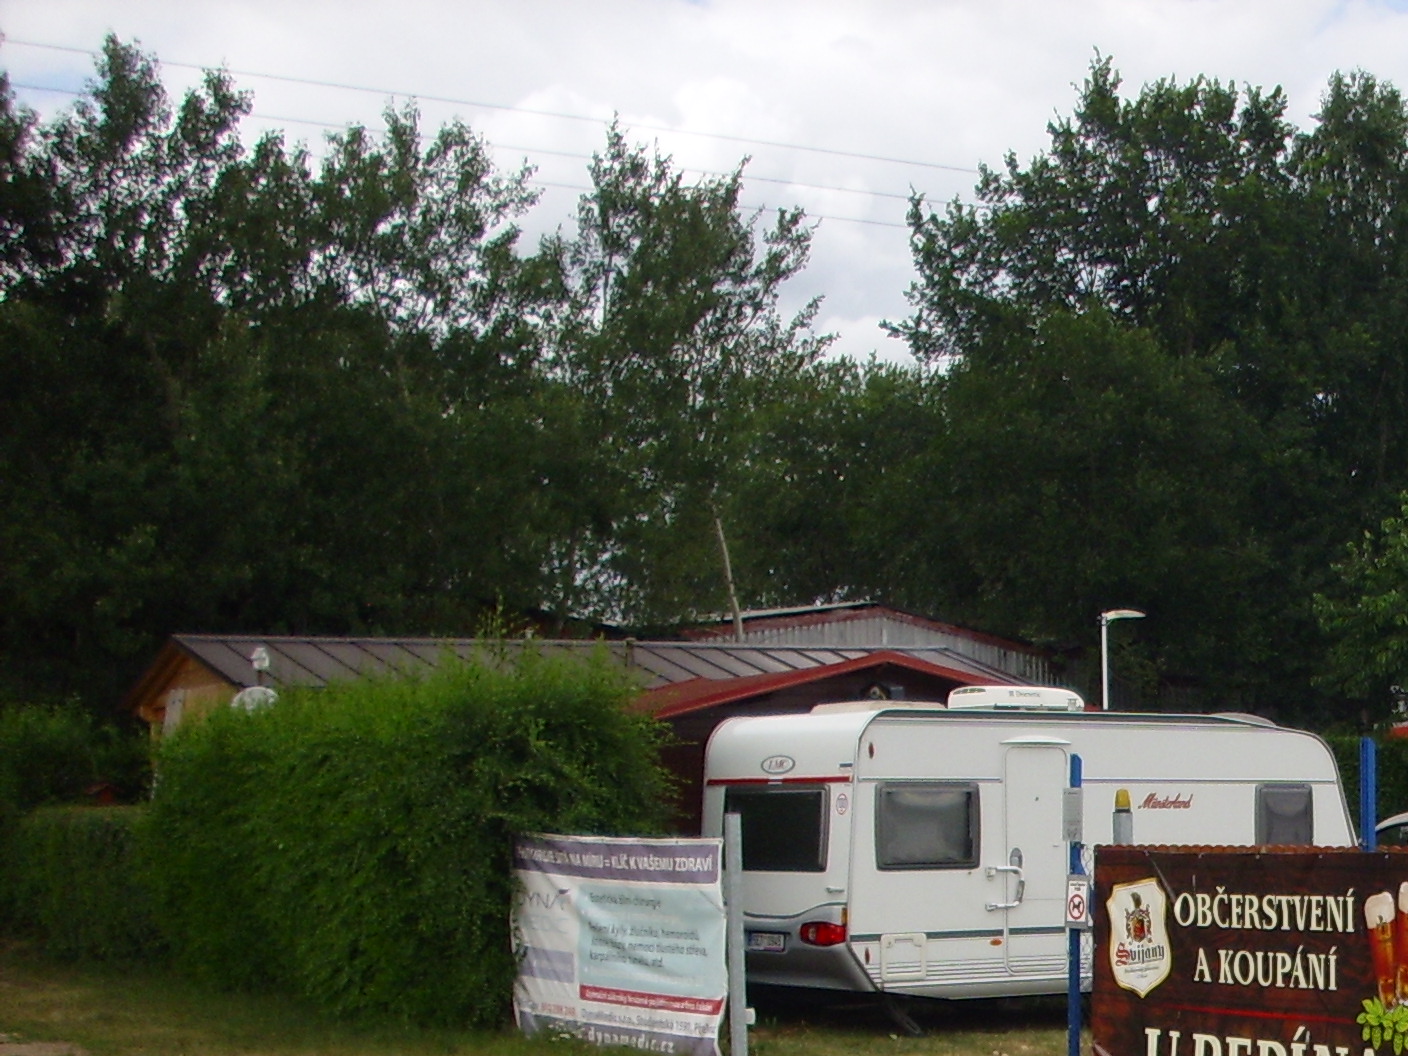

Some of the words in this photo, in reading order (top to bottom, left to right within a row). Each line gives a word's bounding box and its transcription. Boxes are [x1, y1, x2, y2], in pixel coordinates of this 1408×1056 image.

[675, 854, 713, 872] ZDRAVÍ
[1174, 886, 1355, 933] OBČERSTVENÍ
[1116, 942, 1165, 967] Svijany
[1194, 947, 1212, 983] A
[1218, 945, 1338, 991] KOUPÁNÍ
